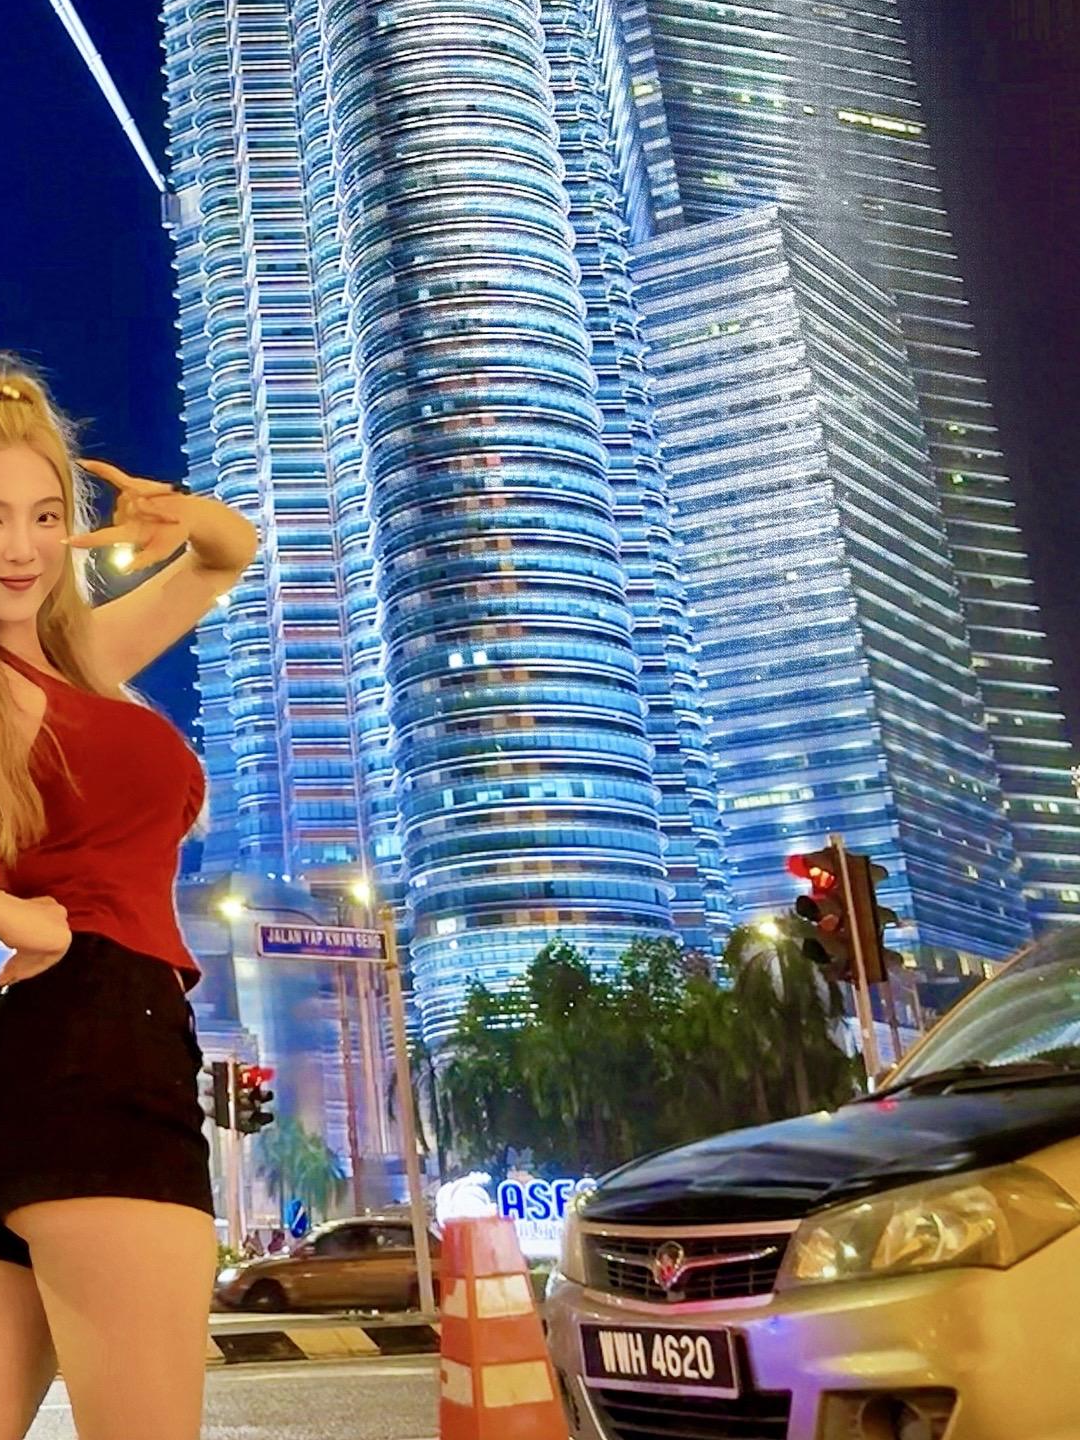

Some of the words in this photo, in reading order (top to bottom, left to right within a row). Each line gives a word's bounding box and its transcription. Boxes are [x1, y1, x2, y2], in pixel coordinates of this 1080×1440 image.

[267, 928, 301, 944] JALAN
[303, 930, 323, 945] YAP
[325, 931, 354, 947] KWAN
[355, 933, 381, 949] SENG
[598, 1330, 648, 1376] WWH
[651, 1333, 716, 1380] 4620
